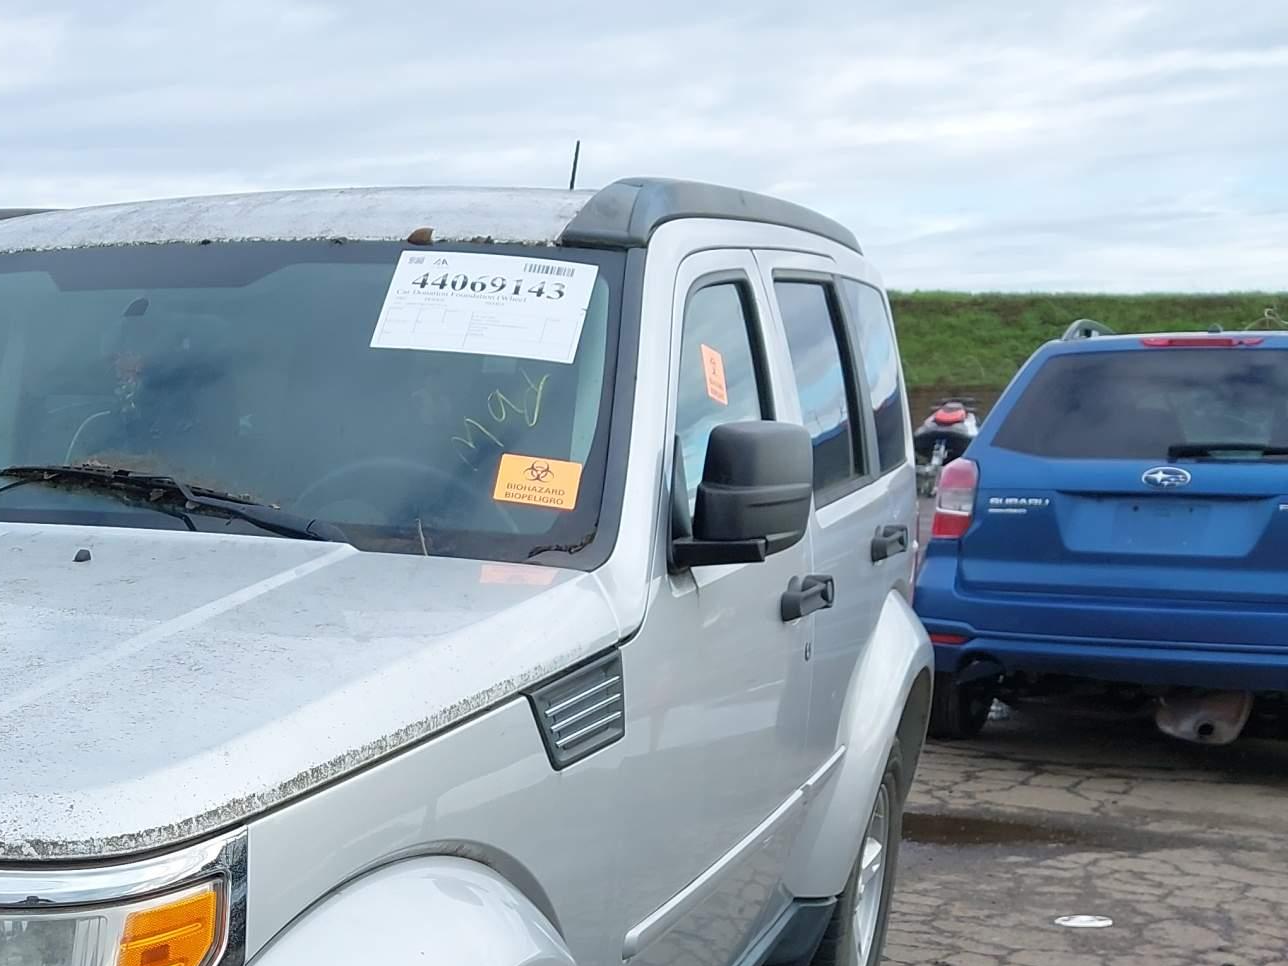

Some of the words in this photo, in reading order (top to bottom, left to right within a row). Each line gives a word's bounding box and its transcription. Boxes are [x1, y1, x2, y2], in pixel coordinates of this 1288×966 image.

[411, 272, 566, 300] 44069143
[506, 482, 566, 496] BIOHAZARD
[504, 491, 564, 505] BIOPELIGRO
[989, 497, 1050, 505] SUBARU
